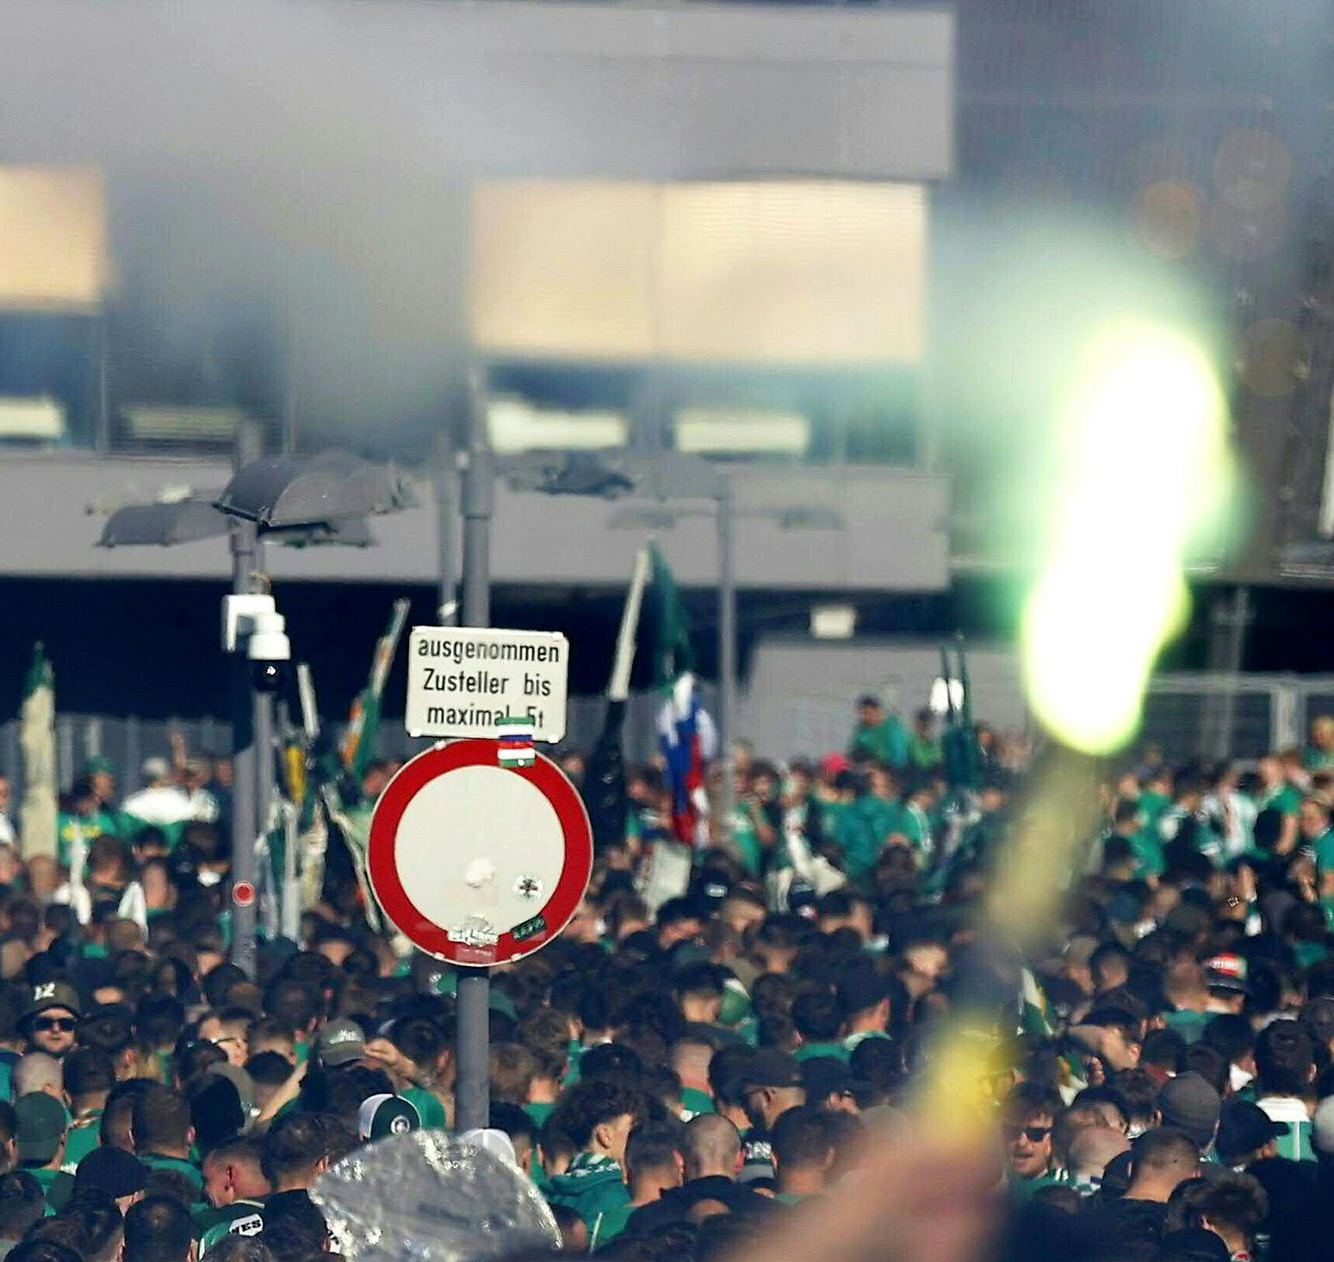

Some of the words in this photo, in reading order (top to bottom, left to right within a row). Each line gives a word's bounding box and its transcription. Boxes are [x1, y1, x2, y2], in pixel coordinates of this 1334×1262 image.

[418, 638, 559, 664] ausgenommen
[423, 667, 509, 695] Zusteller
[523, 672, 551, 696] bis
